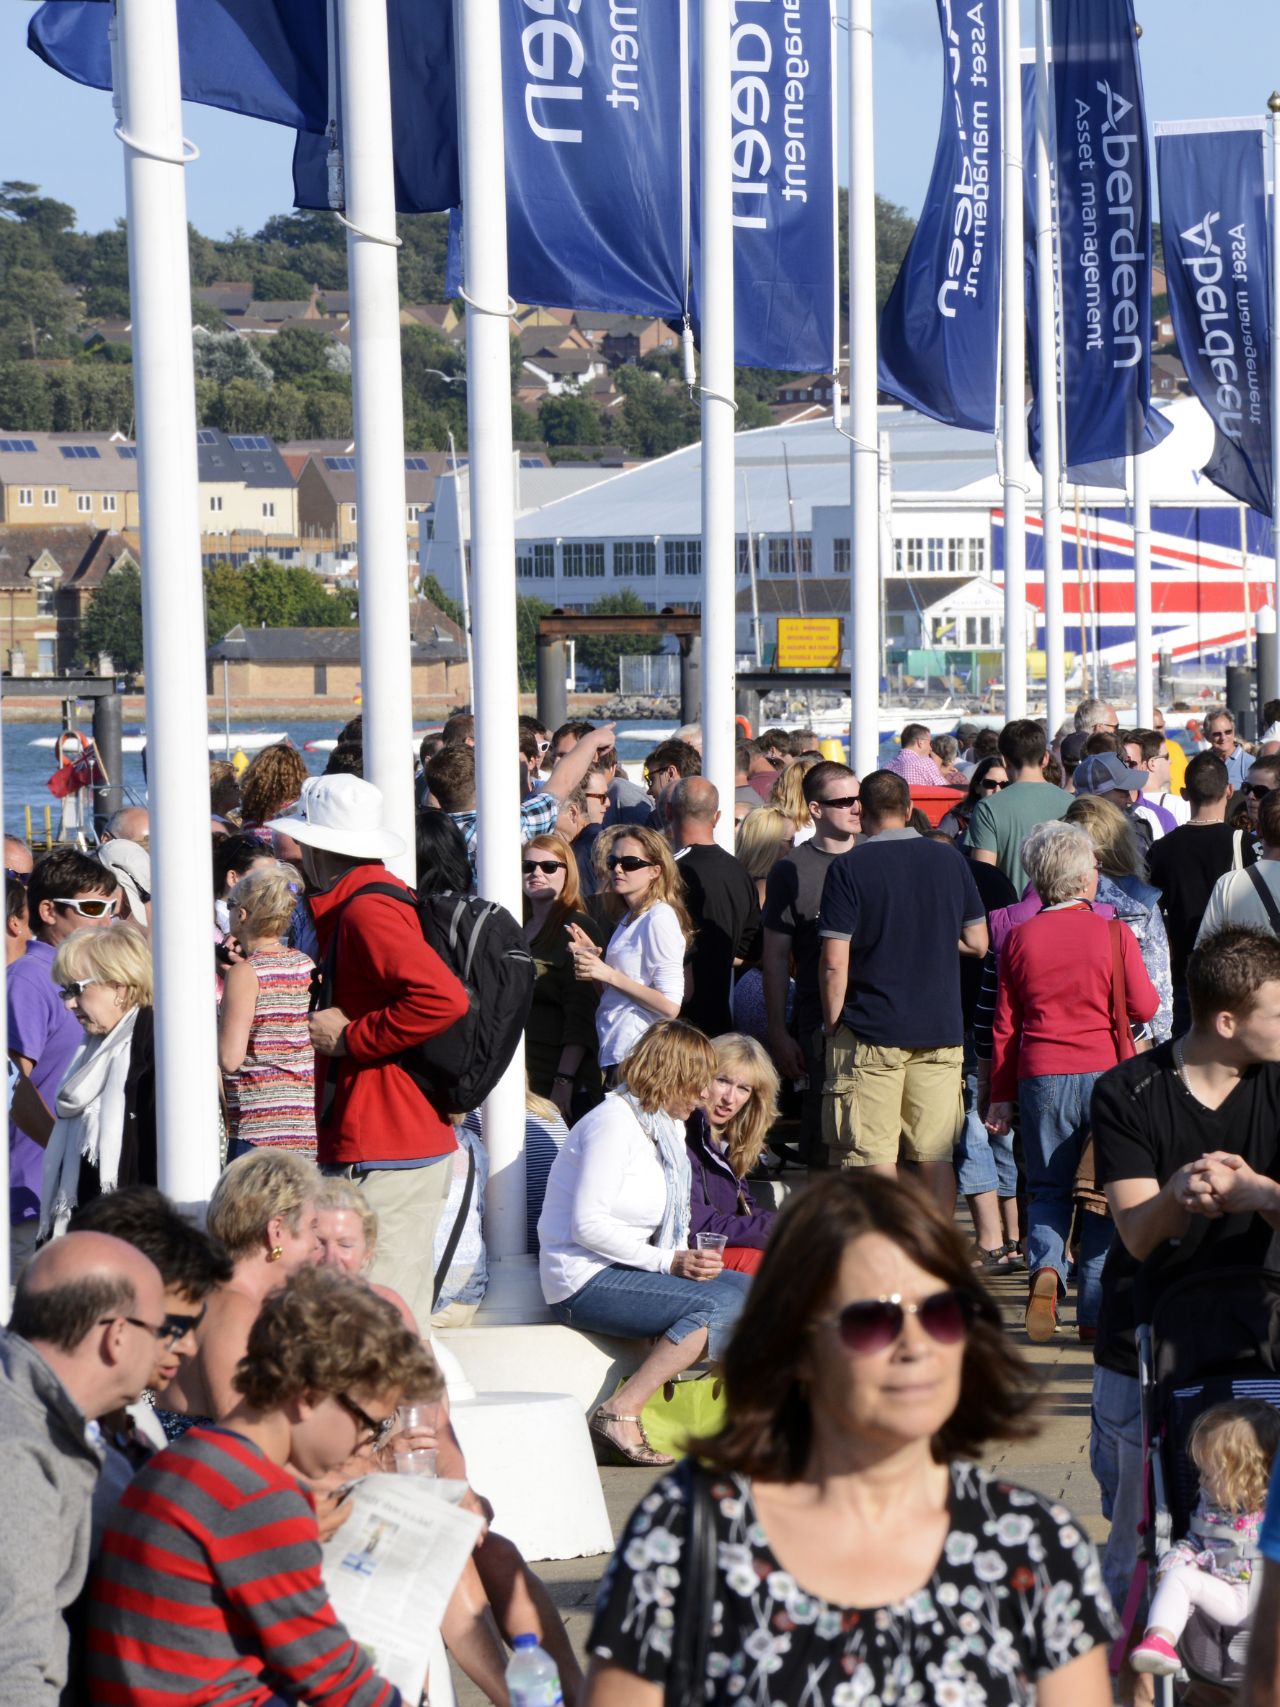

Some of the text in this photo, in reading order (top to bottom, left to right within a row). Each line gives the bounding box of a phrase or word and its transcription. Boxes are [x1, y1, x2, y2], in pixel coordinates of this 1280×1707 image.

[1075, 98, 1106, 351] Asset management
[1096, 79, 1145, 368] Aberdeen
